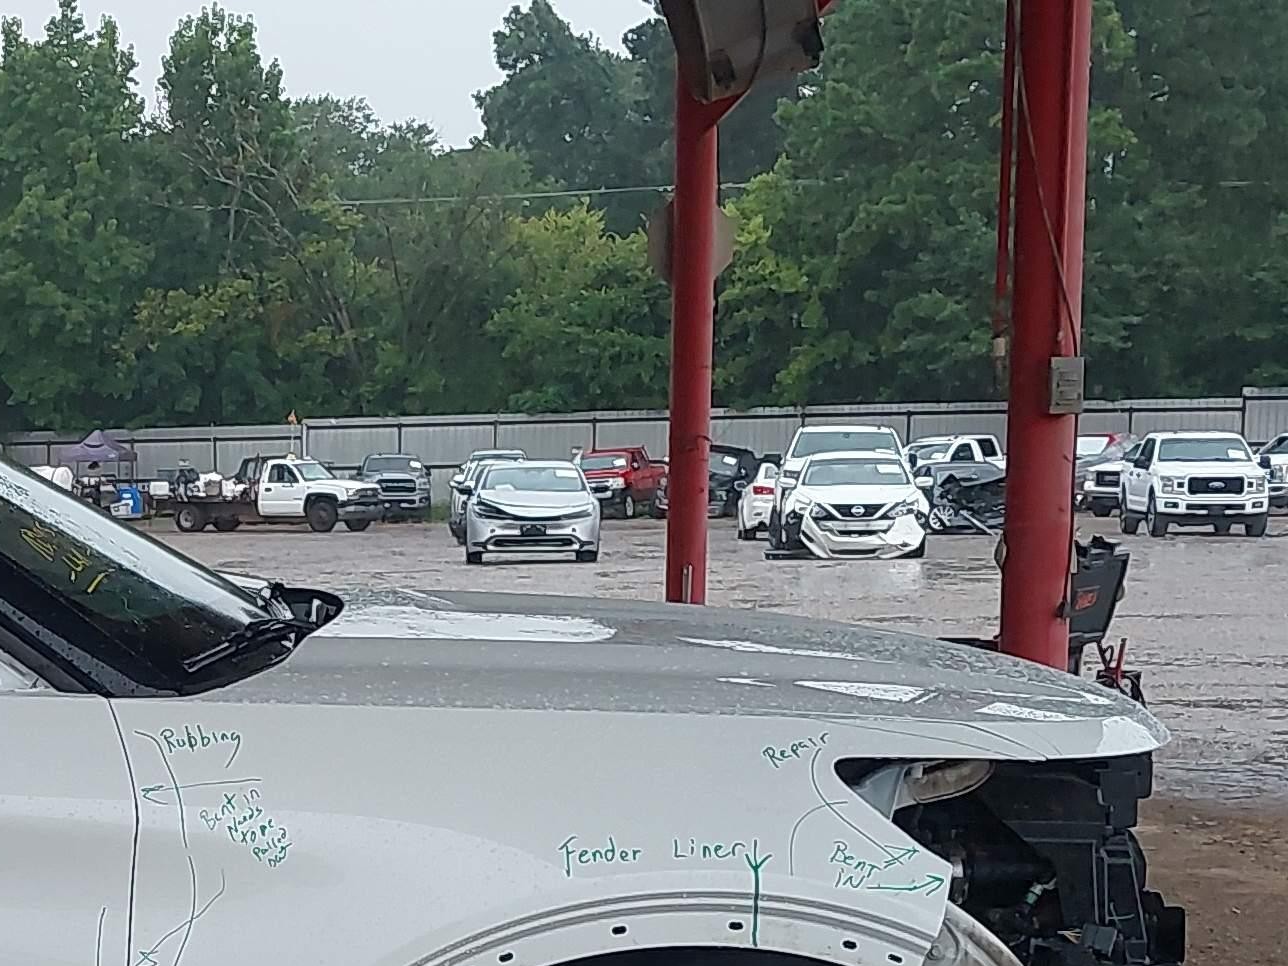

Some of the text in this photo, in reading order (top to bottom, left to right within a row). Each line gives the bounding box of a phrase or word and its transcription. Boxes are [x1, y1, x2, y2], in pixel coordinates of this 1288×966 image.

[159, 724, 241, 769] Rubbing
[762, 732, 830, 769] Repair
[558, 835, 746, 878] Fender Liner
